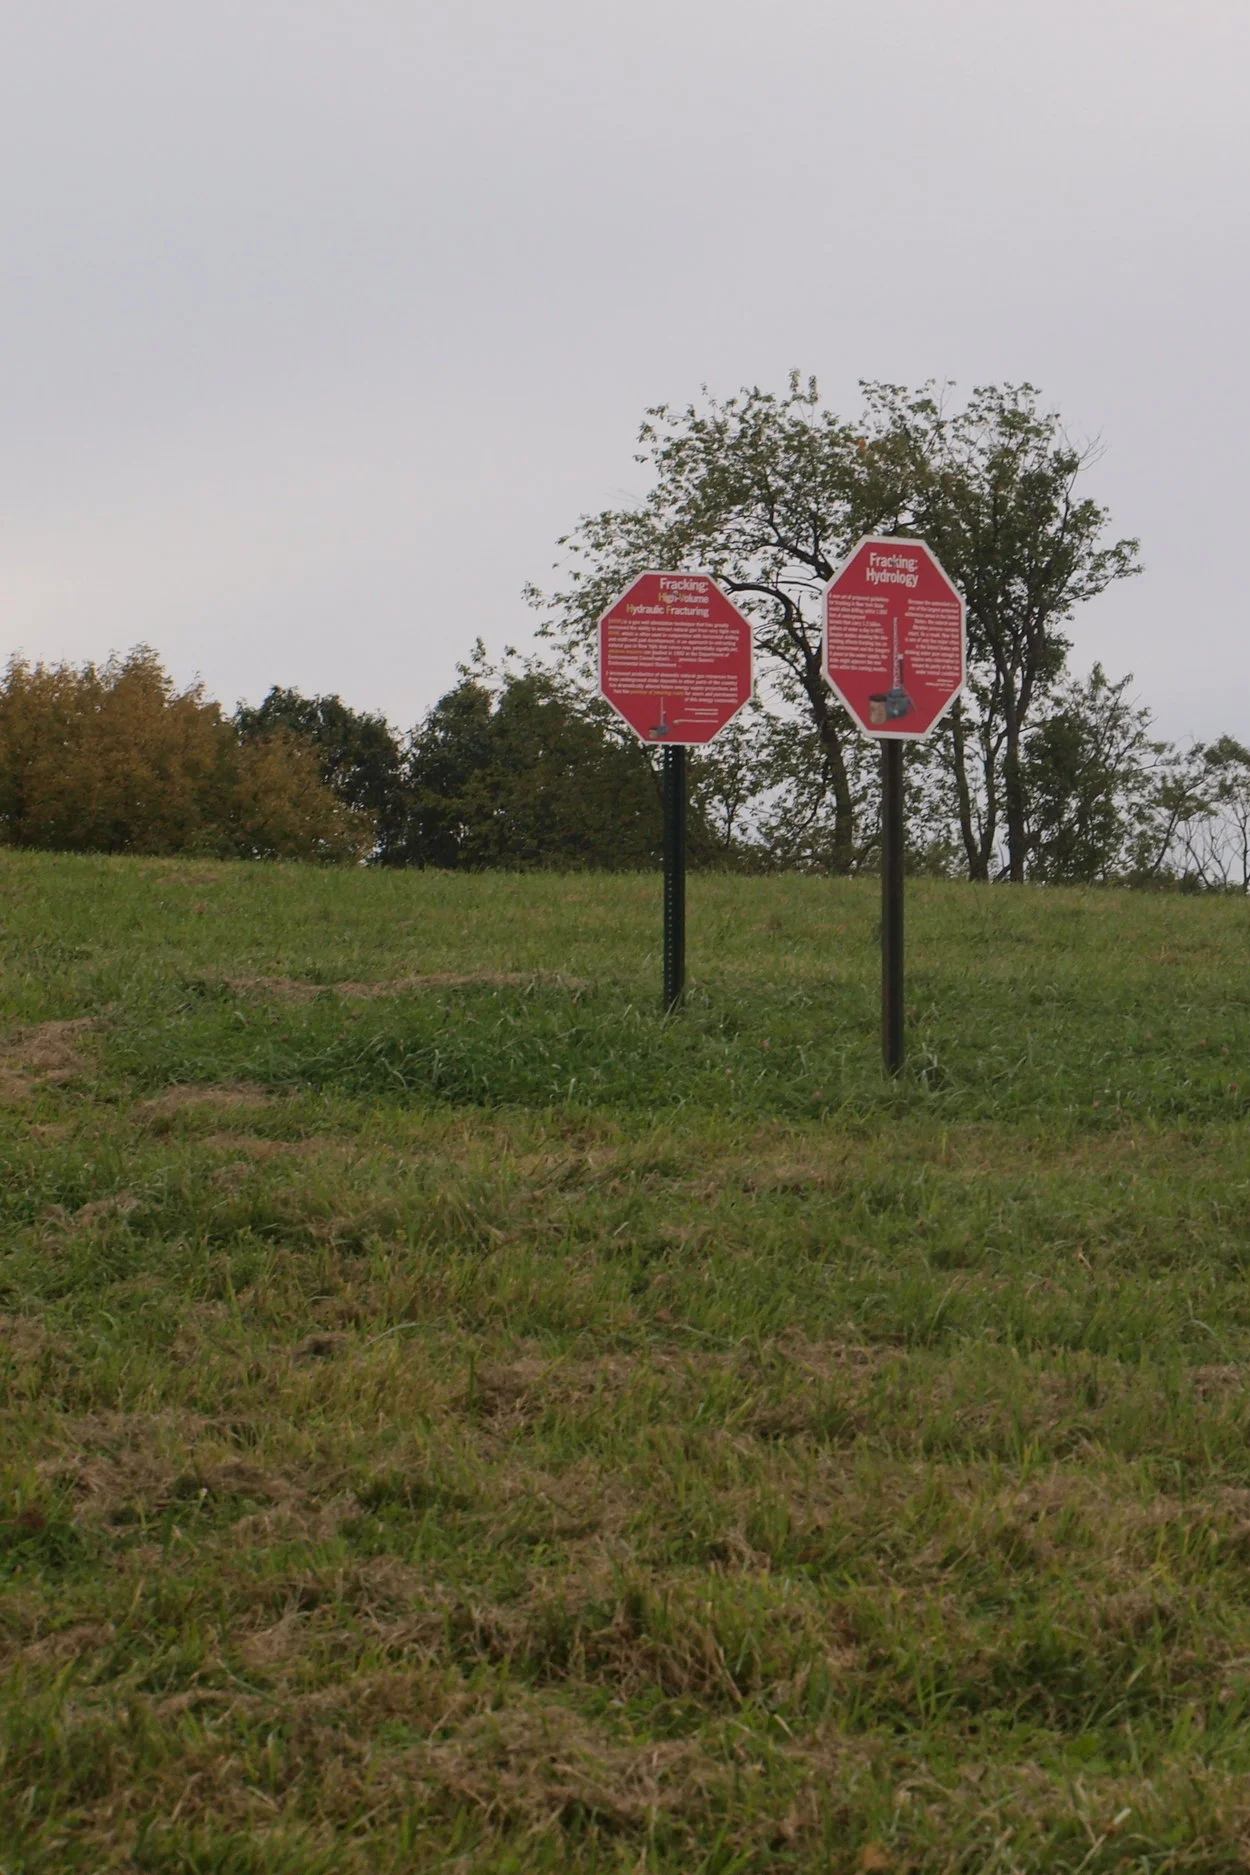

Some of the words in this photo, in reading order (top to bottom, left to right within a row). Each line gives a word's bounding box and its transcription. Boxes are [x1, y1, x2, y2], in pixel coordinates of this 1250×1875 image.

[870, 552, 918, 572] Fracking:
[659, 577, 709, 593] Fracking:
[866, 567, 919, 588] Hydrology
[626, 603, 665, 616] Hydraulic
[666, 605, 709, 618] Fracturing
